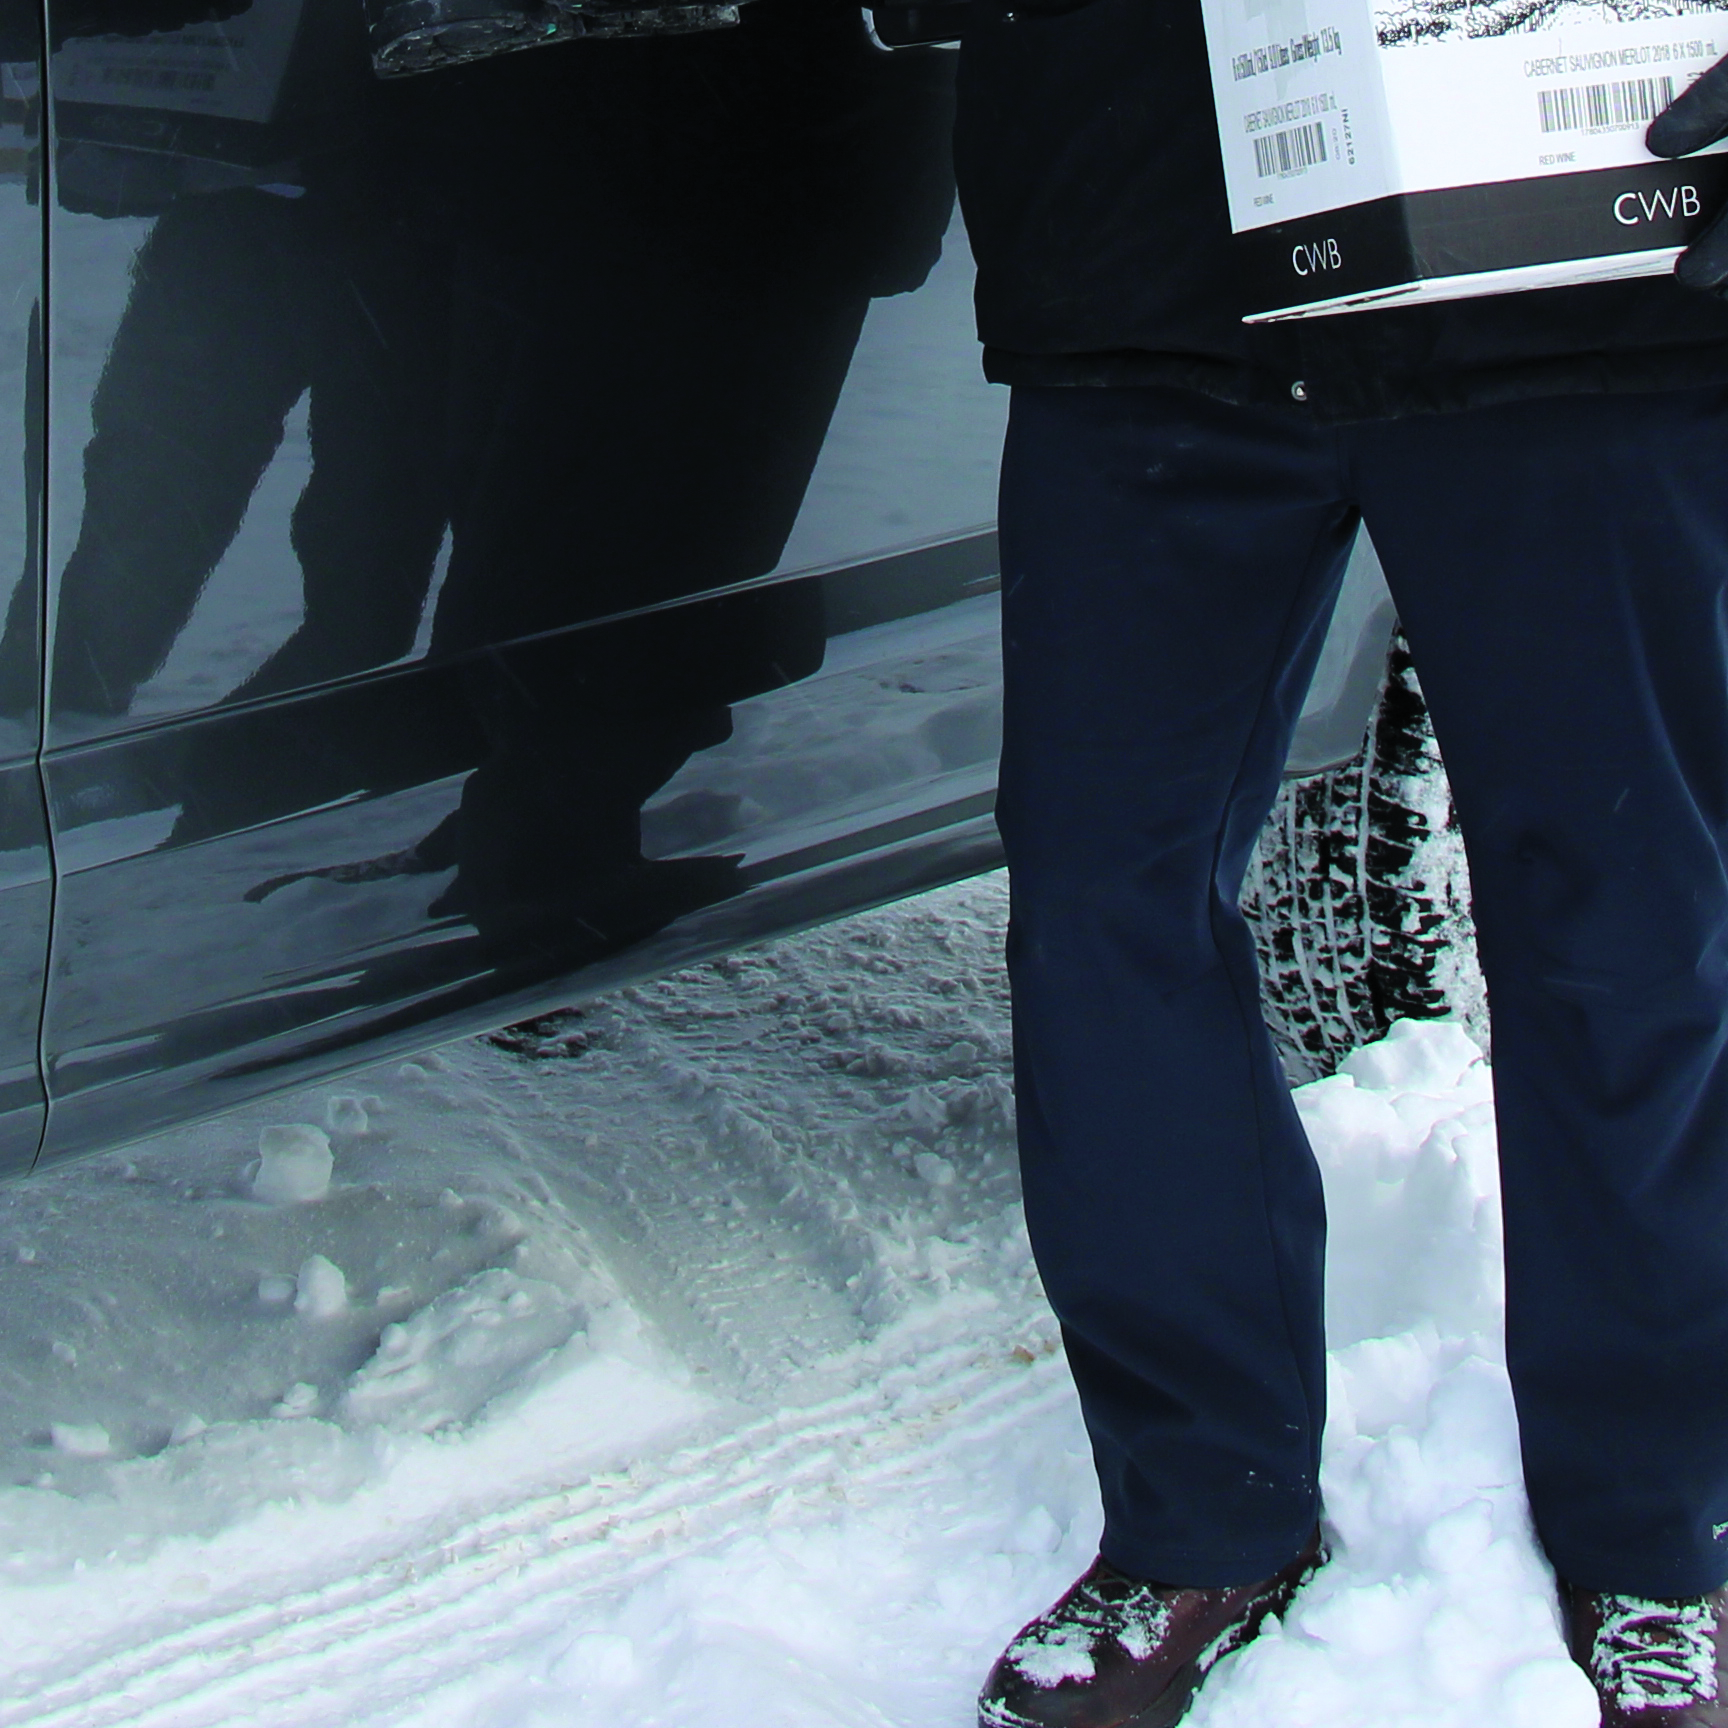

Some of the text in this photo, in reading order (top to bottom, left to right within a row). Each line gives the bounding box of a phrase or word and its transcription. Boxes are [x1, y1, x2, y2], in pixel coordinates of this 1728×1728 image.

[1524, 56, 1568, 78] CABERNET
[1569, 50, 1617, 72] SAUVIGNON
[1618, 46, 1652, 66] MERLOT
[1539, 151, 1577, 165] RED WINE
[1613, 185, 1701, 225] CWB
[1292, 238, 1342, 276] CWB
